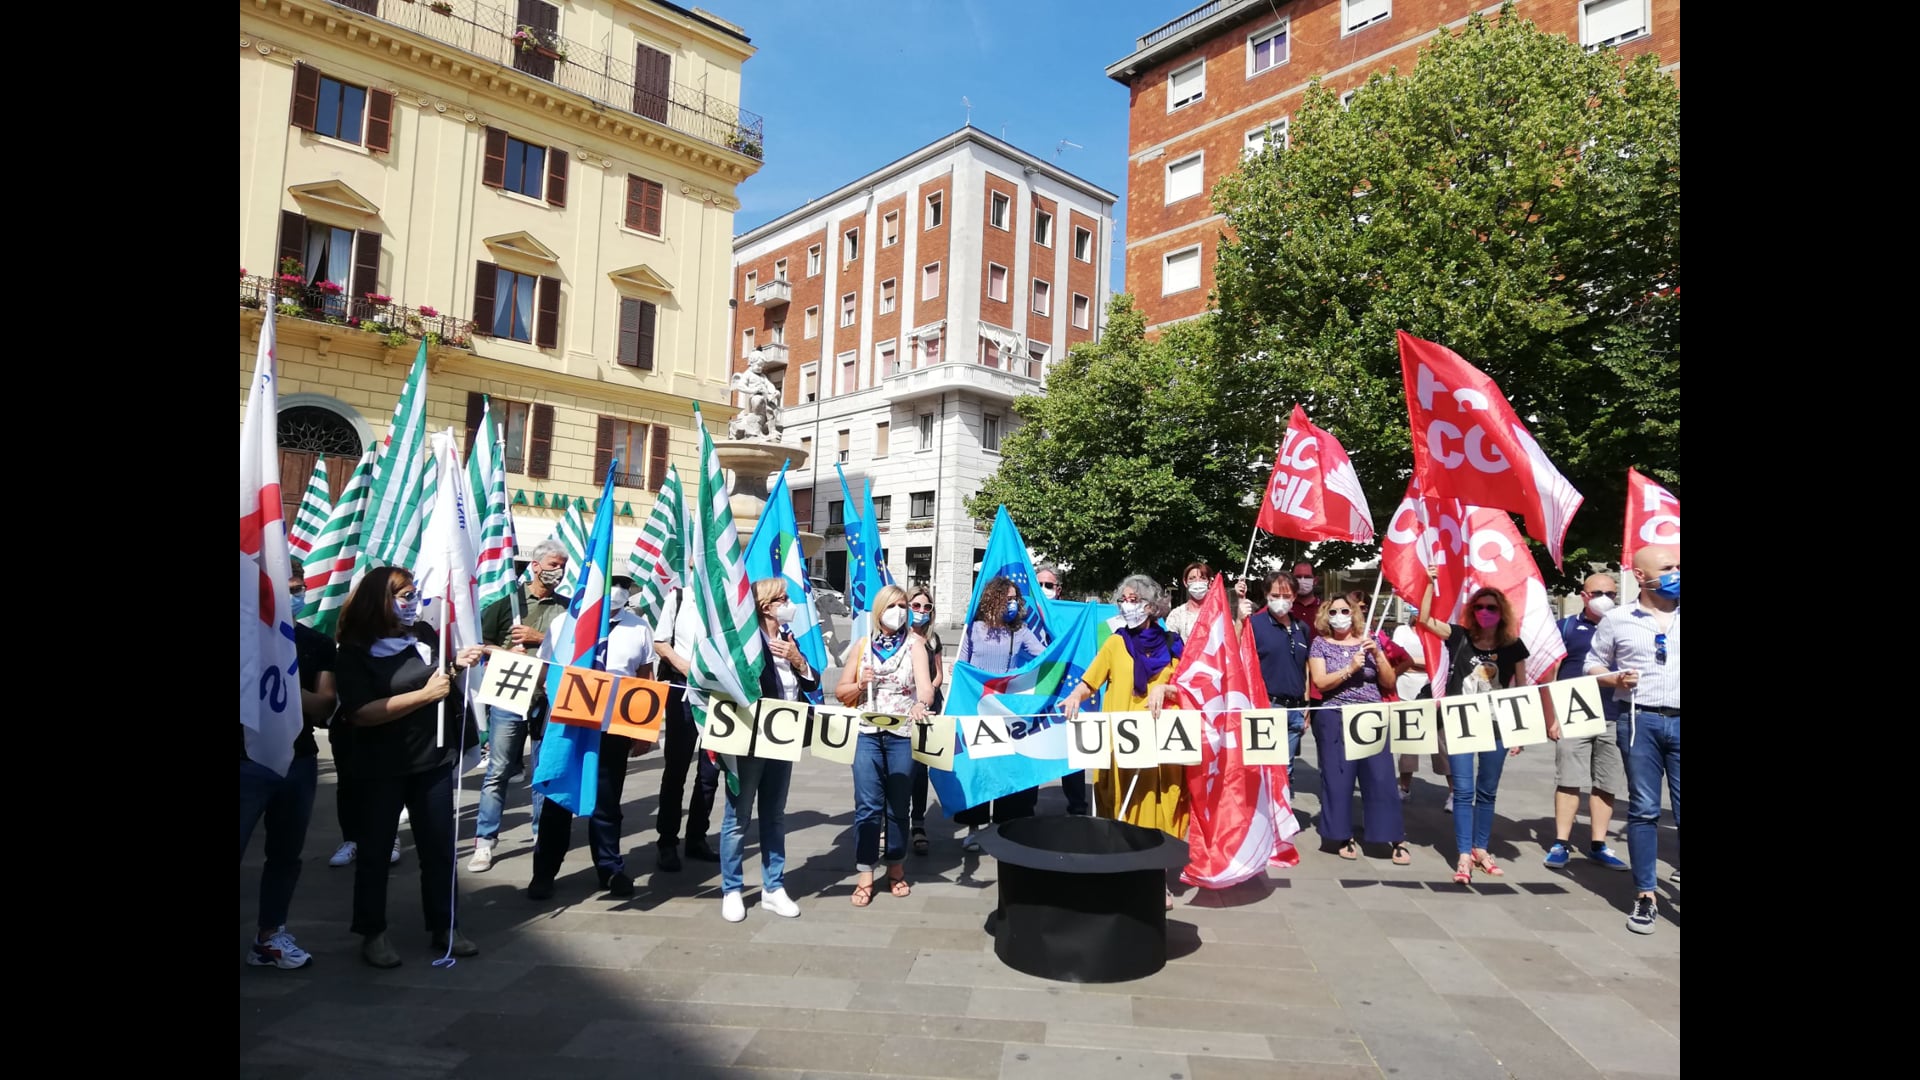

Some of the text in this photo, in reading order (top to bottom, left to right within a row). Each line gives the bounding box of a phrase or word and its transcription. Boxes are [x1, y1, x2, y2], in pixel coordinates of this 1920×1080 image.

[512, 488, 634, 518] ARMACA
[1270, 470, 1315, 520] GIL
[708, 700, 1009, 758] SCUOLA
[1069, 715, 1198, 755] USA
[1244, 716, 1278, 752] E
[1348, 686, 1601, 746] GETTA
